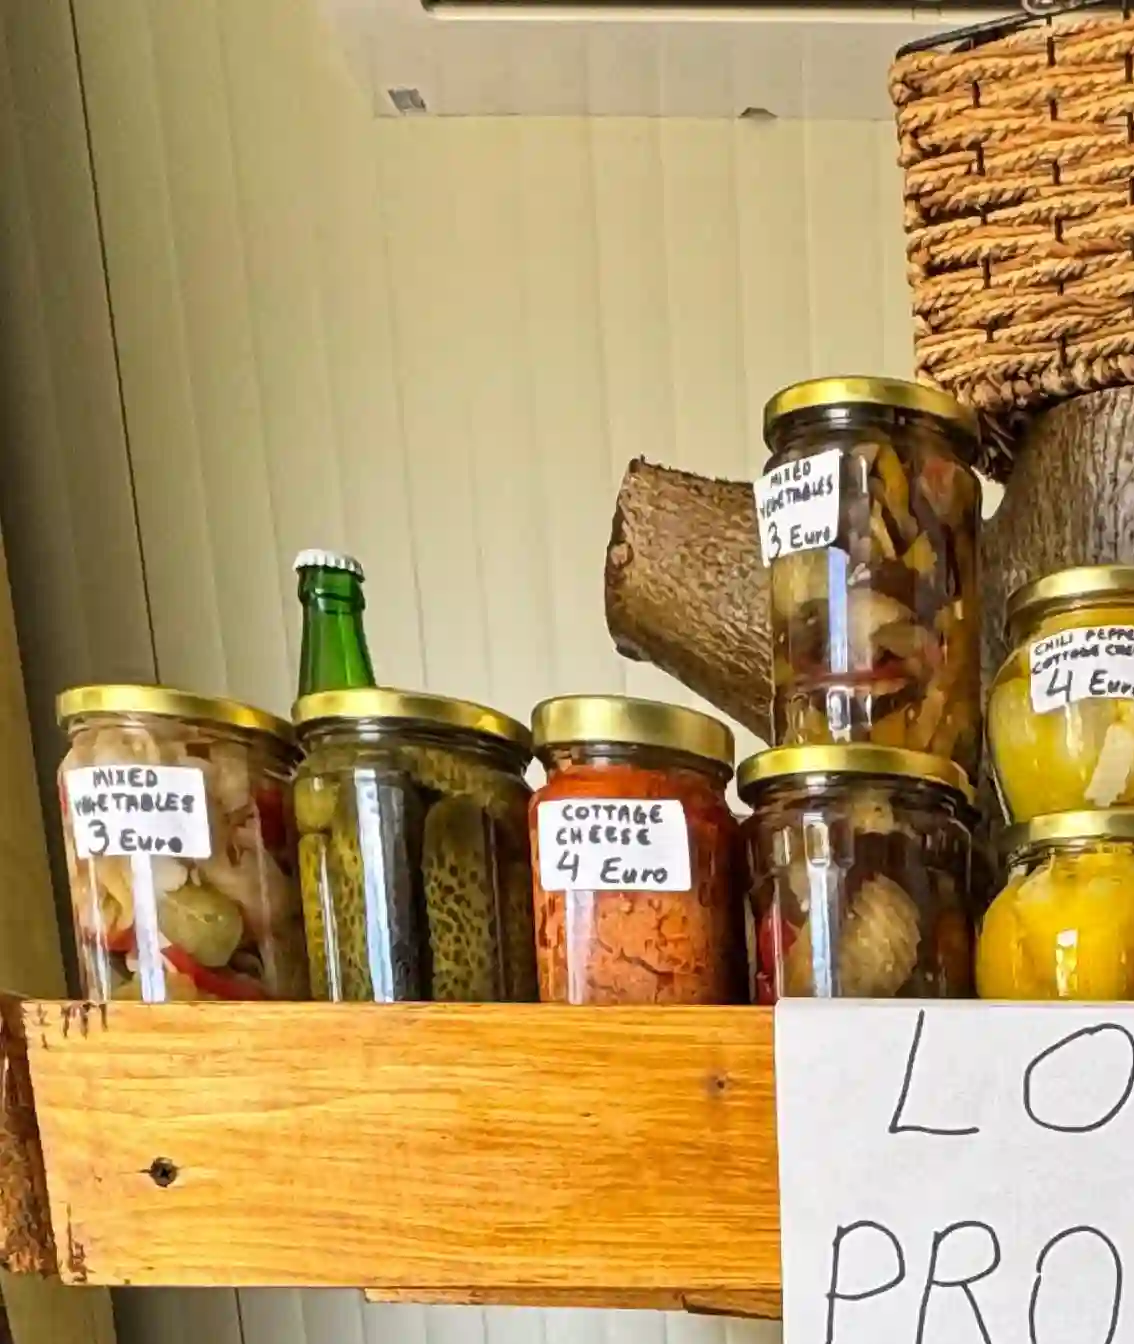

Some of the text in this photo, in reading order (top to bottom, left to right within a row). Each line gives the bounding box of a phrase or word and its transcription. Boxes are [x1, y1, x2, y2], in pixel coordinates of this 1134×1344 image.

[768, 521, 830, 559] 3 Euro
[1034, 632, 1073, 655] CHILI
[1046, 668, 1072, 702] 4
[93, 767, 158, 788] MIXED
[562, 804, 663, 825] COTTAGE
[88, 819, 183, 856] 3 Euro
[555, 825, 652, 845] CHEESE
[557, 850, 668, 884] 4 Euro
